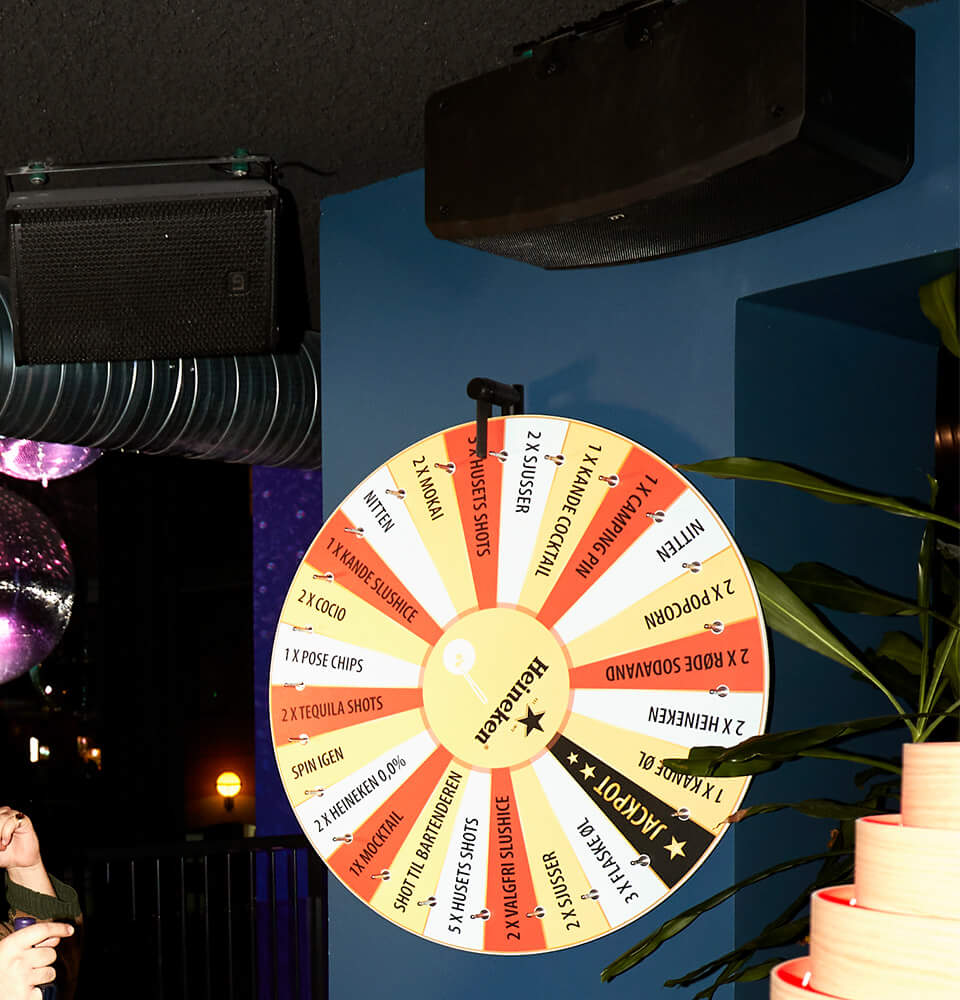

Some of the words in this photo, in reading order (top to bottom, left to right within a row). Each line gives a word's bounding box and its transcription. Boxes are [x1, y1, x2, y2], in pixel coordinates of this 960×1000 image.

[526, 442, 540, 452] X
[527, 431, 542, 440] 2
[588, 444, 602, 452] 1
[413, 456, 425, 467] 2
[416, 466, 430, 478] X
[582, 454, 598, 466] X
[470, 458, 487, 510] HUSETS
[515, 455, 538, 514] SJUSSER
[562, 466, 594, 515] KANDE
[636, 482, 652, 497] X
[645, 474, 658, 485] 1
[420, 477, 444, 521] MOKAI
[363, 490, 395, 534] NITTEN
[474, 514, 490, 557] SHOTS
[592, 494, 642, 556] CAMPING
[534, 516, 572, 577] COCKTAIL
[656, 518, 705, 563] NITTEN
[576, 552, 600, 579] PIN
[326, 537, 334, 550] 1
[332, 542, 344, 558] X
[340, 548, 374, 584] KANDE
[370, 577, 419, 624] SLUSHICE
[711, 584, 724, 602] X
[723, 579, 735, 594] 2
[298, 589, 306, 604] 2
[306, 594, 316, 608] X
[315, 597, 346, 622] COCIO
[644, 590, 711, 630] POPCORN
[284, 648, 290, 661] 1
[292, 648, 300, 662] X
[302, 650, 328, 668] POSE
[331, 655, 364, 672] CHIPS
[684, 651, 724, 672] RØDE
[728, 650, 736, 667] X
[740, 648, 750, 664] 2
[606, 656, 681, 682] SODAVAND
[282, 708, 288, 722] 2
[290, 706, 298, 720] X
[300, 702, 345, 720] TEQUILA
[348, 696, 384, 714] SHOTS
[474, 656, 549, 744] Heineken
[648, 706, 720, 732] HEINEKEN
[722, 718, 732, 735] X
[736, 720, 746, 736] 2
[292, 758, 317, 780] SPIN
[318, 746, 344, 768] IGEN
[638, 751, 656, 770] ØL
[314, 819, 324, 832] 2
[320, 812, 332, 826] X
[329, 775, 380, 820] HEINEKEN
[378, 755, 406, 782] 0,0%
[702, 782, 715, 800] X
[715, 788, 724, 803] 1
[593, 775, 668, 841] JACKPOT
[360, 810, 404, 865] MOCKTAIL
[460, 817, 479, 860] SHOTS
[496, 795, 514, 859] SLUSHICE
[576, 817, 596, 838] ØL
[394, 878, 416, 913] SHOT
[406, 861, 424, 880] TIL
[416, 770, 463, 860] BARTENDEREN
[586, 834, 624, 884] FLASKE
[452, 862, 472, 912] HUSETS
[500, 862, 520, 918] VALGFRI
[542, 850, 572, 908] SJUSSER
[616, 880, 632, 895] X
[624, 892, 639, 904] 3
[450, 913, 463, 924] X
[506, 920, 520, 928] X
[561, 908, 576, 920] X
[566, 920, 580, 930] 2
[448, 924, 461, 934] 5
[507, 932, 520, 940] 2
